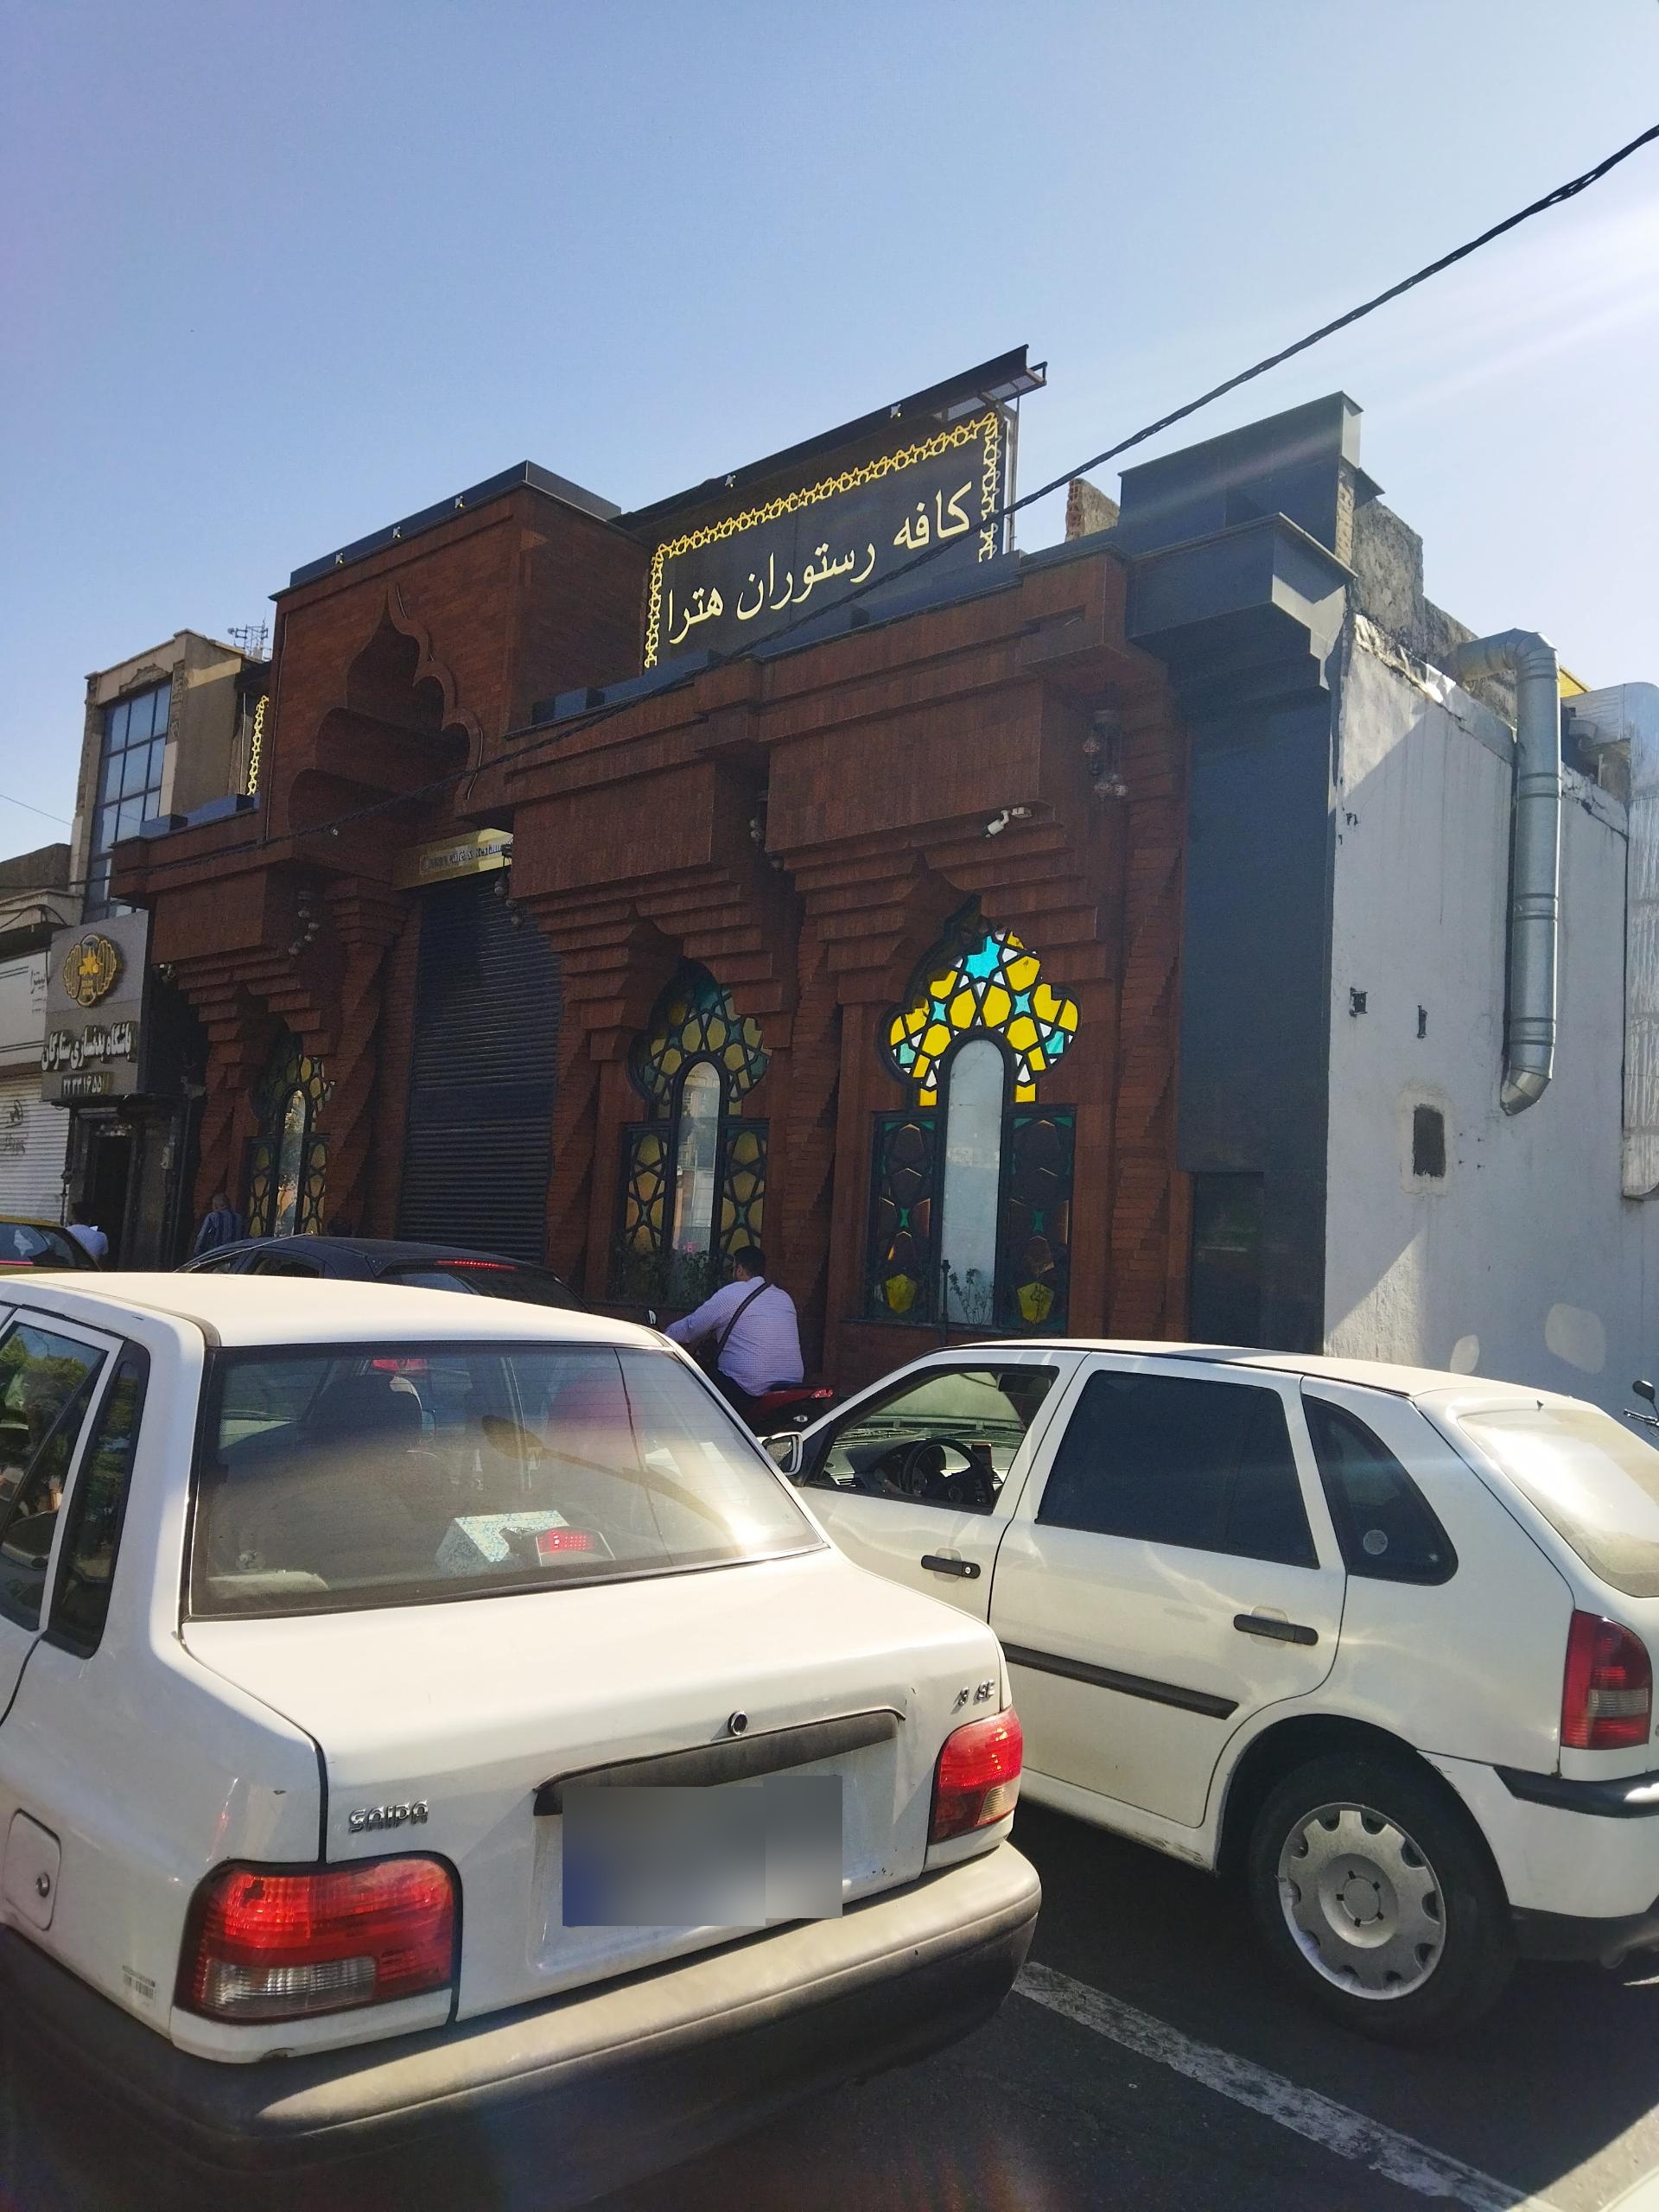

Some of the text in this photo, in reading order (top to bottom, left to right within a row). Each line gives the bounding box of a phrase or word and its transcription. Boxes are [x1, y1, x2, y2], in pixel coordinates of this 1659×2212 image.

[667, 480, 972, 645] کافه رستوران هترا
[105, 1022, 131, 1061] باشگاه
